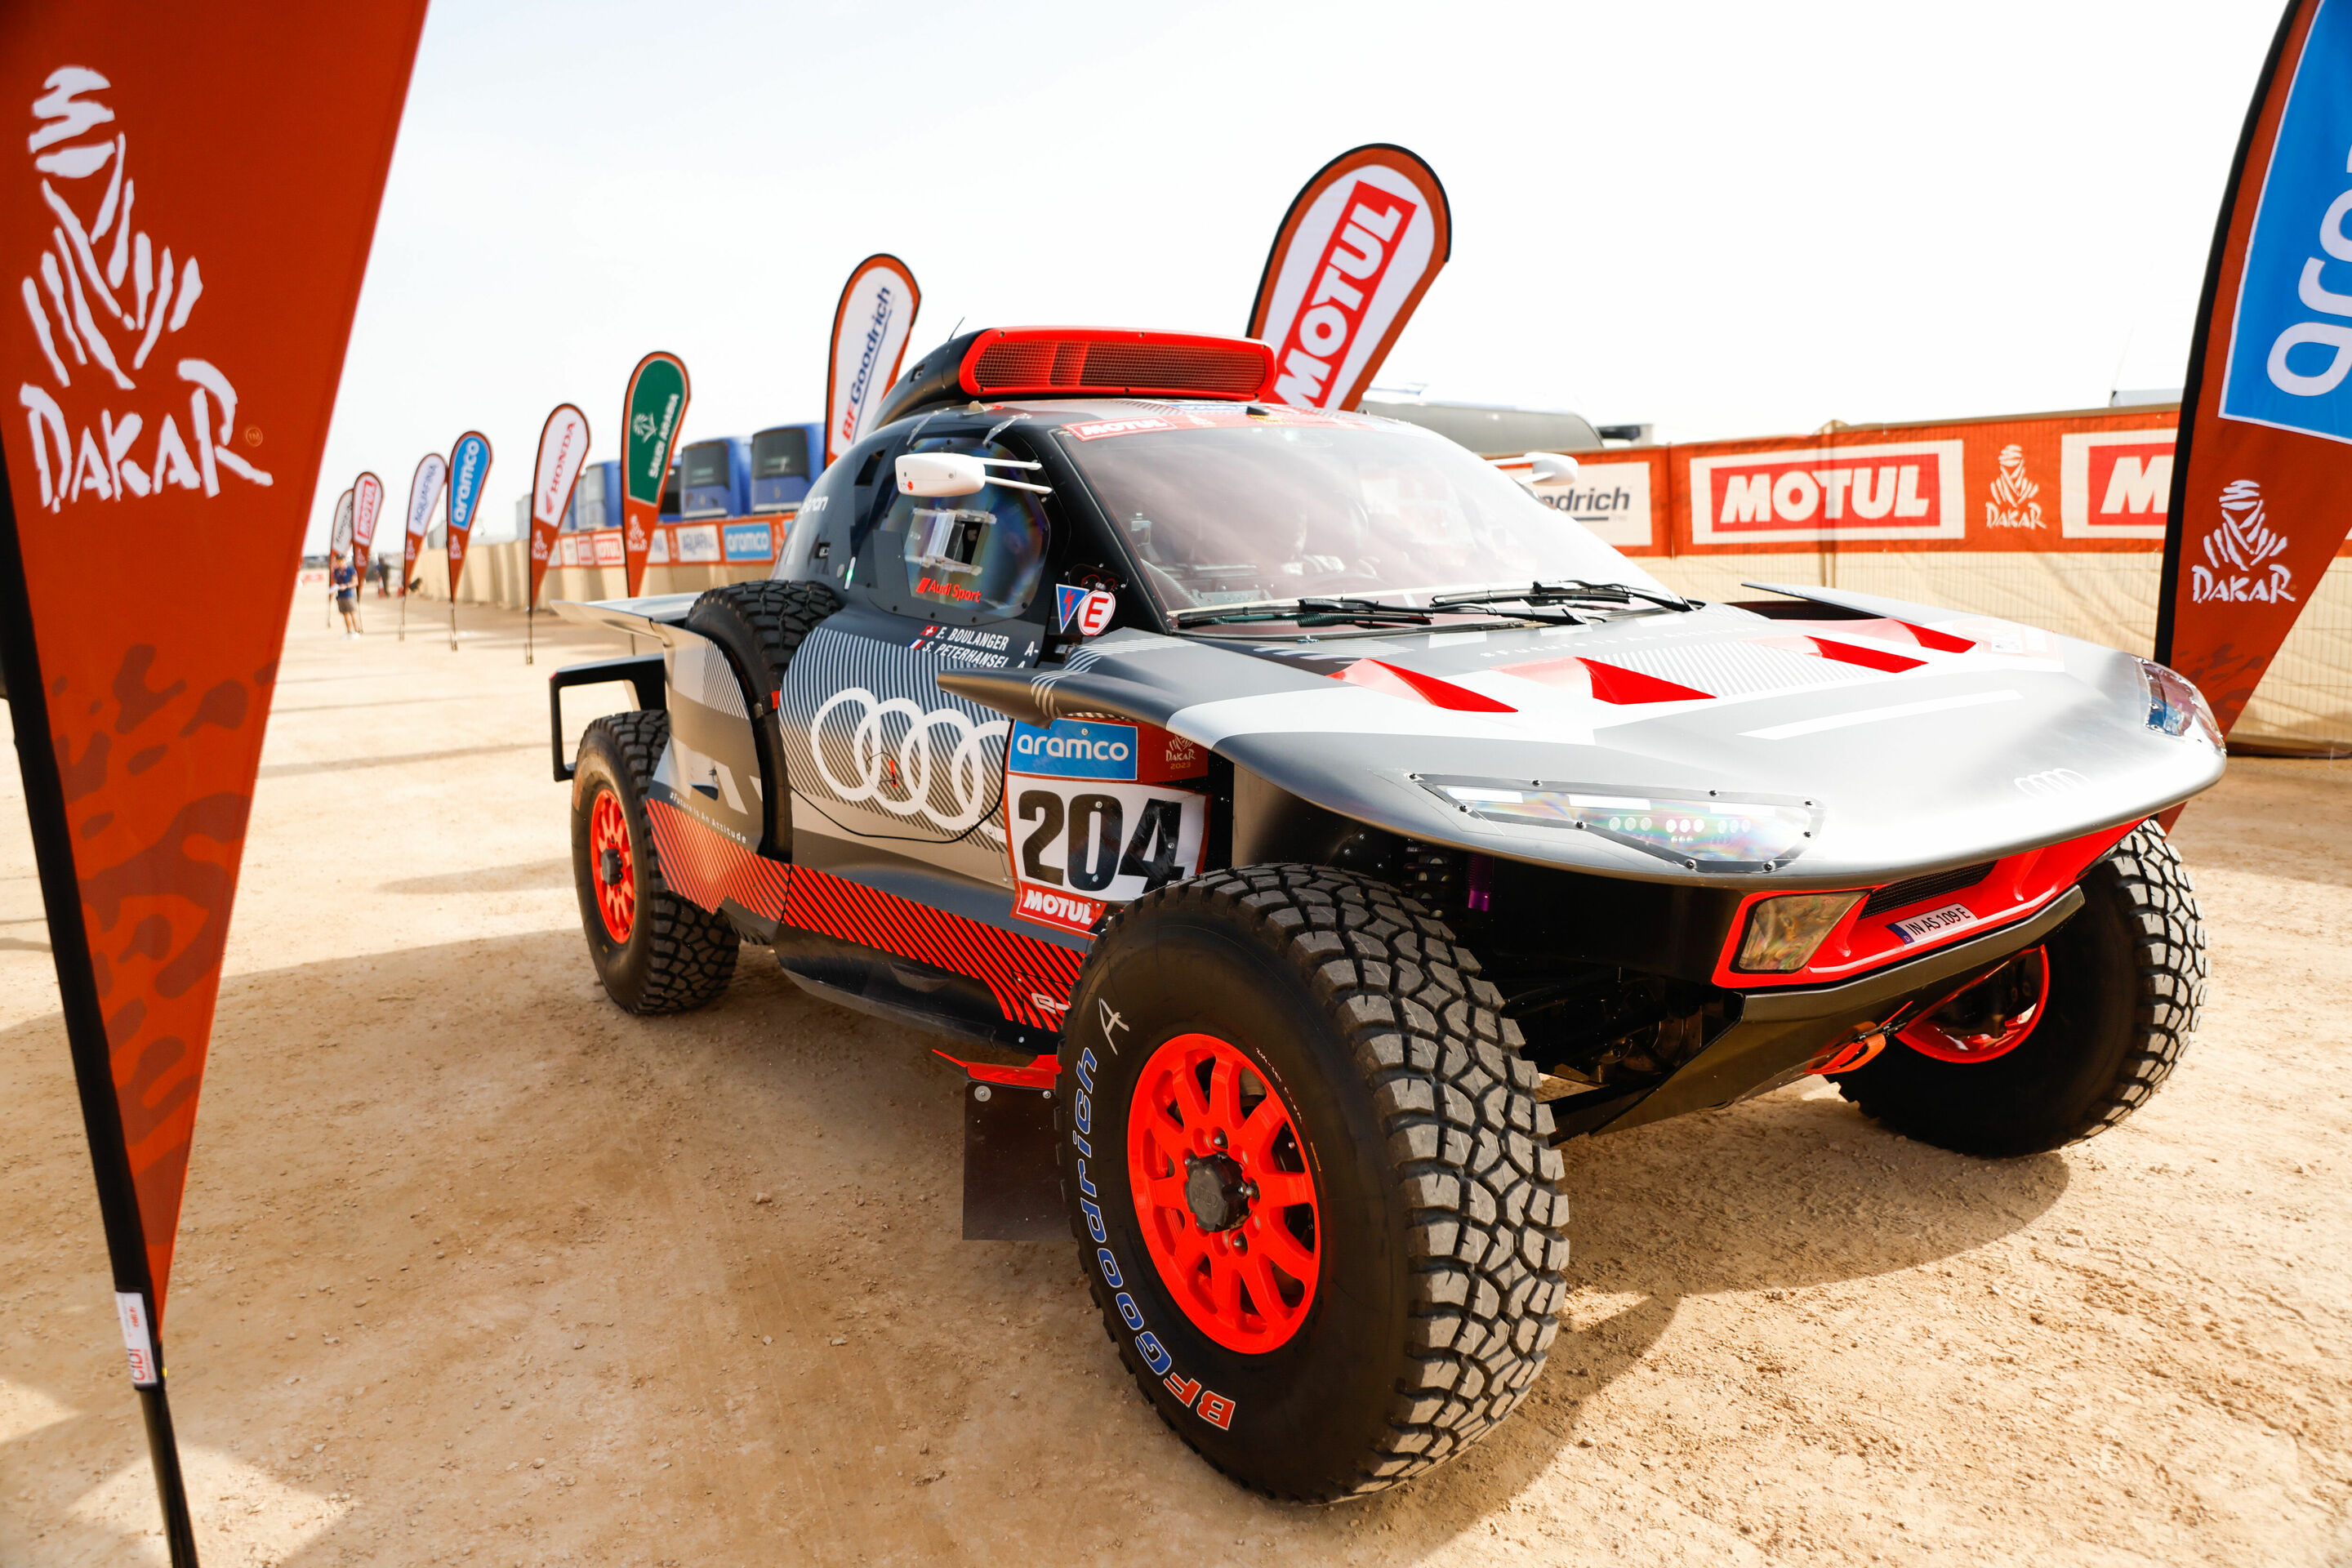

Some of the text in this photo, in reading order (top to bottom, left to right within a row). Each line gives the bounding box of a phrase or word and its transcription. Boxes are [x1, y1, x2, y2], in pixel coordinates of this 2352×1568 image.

[1273, 202, 1403, 408] MOTUL
[842, 286, 891, 441] BFGoodrich
[19, 358, 274, 514] DAKAR
[648, 393, 679, 479] SAUDI ARABIA
[1080, 418, 1169, 436] MOTUL
[550, 421, 576, 494] HONDA
[454, 439, 480, 523] aramco
[1719, 465, 1930, 523] MOTUL
[1542, 488, 1630, 511] odrich
[1985, 501, 2047, 529] DAKAR
[727, 532, 769, 553] aramco
[929, 579, 982, 604] Audi Sport
[2191, 564, 2296, 604] DAKAR
[1084, 595, 1109, 628] E
[922, 641, 935, 653] S.
[935, 626, 948, 639] E.
[947, 628, 1010, 652] BOULANGER
[1017, 734, 1129, 761] aramco
[1165, 748, 1196, 762] DAKAR
[1170, 761, 1192, 770] 2023
[711, 818, 746, 844] Attitude
[1018, 789, 1185, 893] 204
[1022, 889, 1094, 925] MOTUL
[1905, 907, 1971, 936] IN AS 109 E
[1071, 1045, 1236, 1432] BFGoodrich
